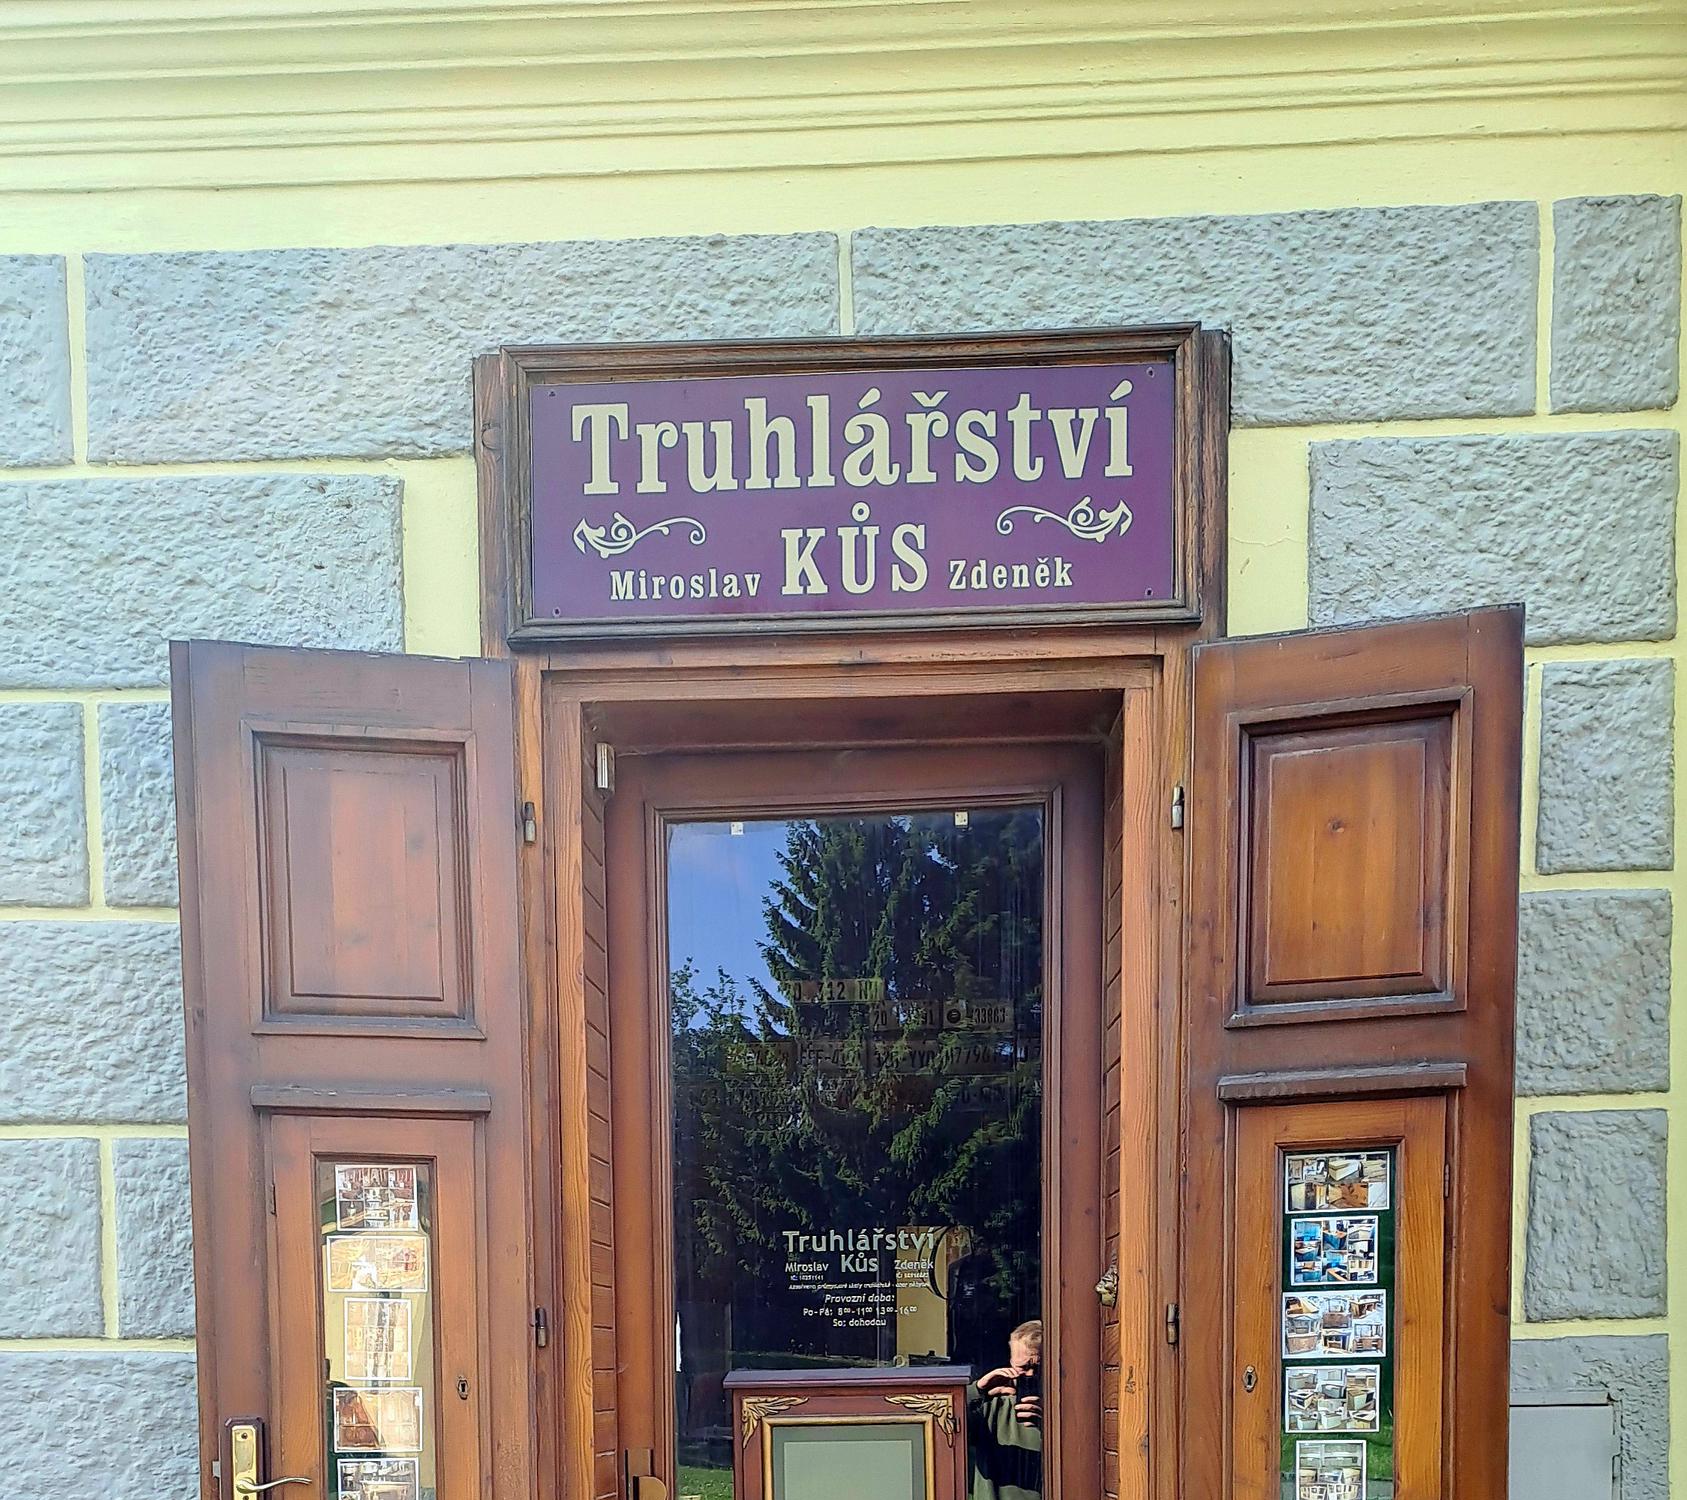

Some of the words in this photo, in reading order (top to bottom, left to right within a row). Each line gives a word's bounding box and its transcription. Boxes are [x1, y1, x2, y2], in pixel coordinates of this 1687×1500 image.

[570, 379, 1134, 496] Truhlářství
[609, 568, 761, 601] Miroslav
[780, 501, 928, 596] KŮS
[949, 556, 1074, 590] Zdeněk
[782, 1227, 934, 1252] Truhlářství
[785, 1261, 829, 1273] Miroslav
[841, 1252, 879, 1273] Kůs
[894, 1259, 934, 1271] Zdeněk
[868, 1293, 895, 1303] doba:
